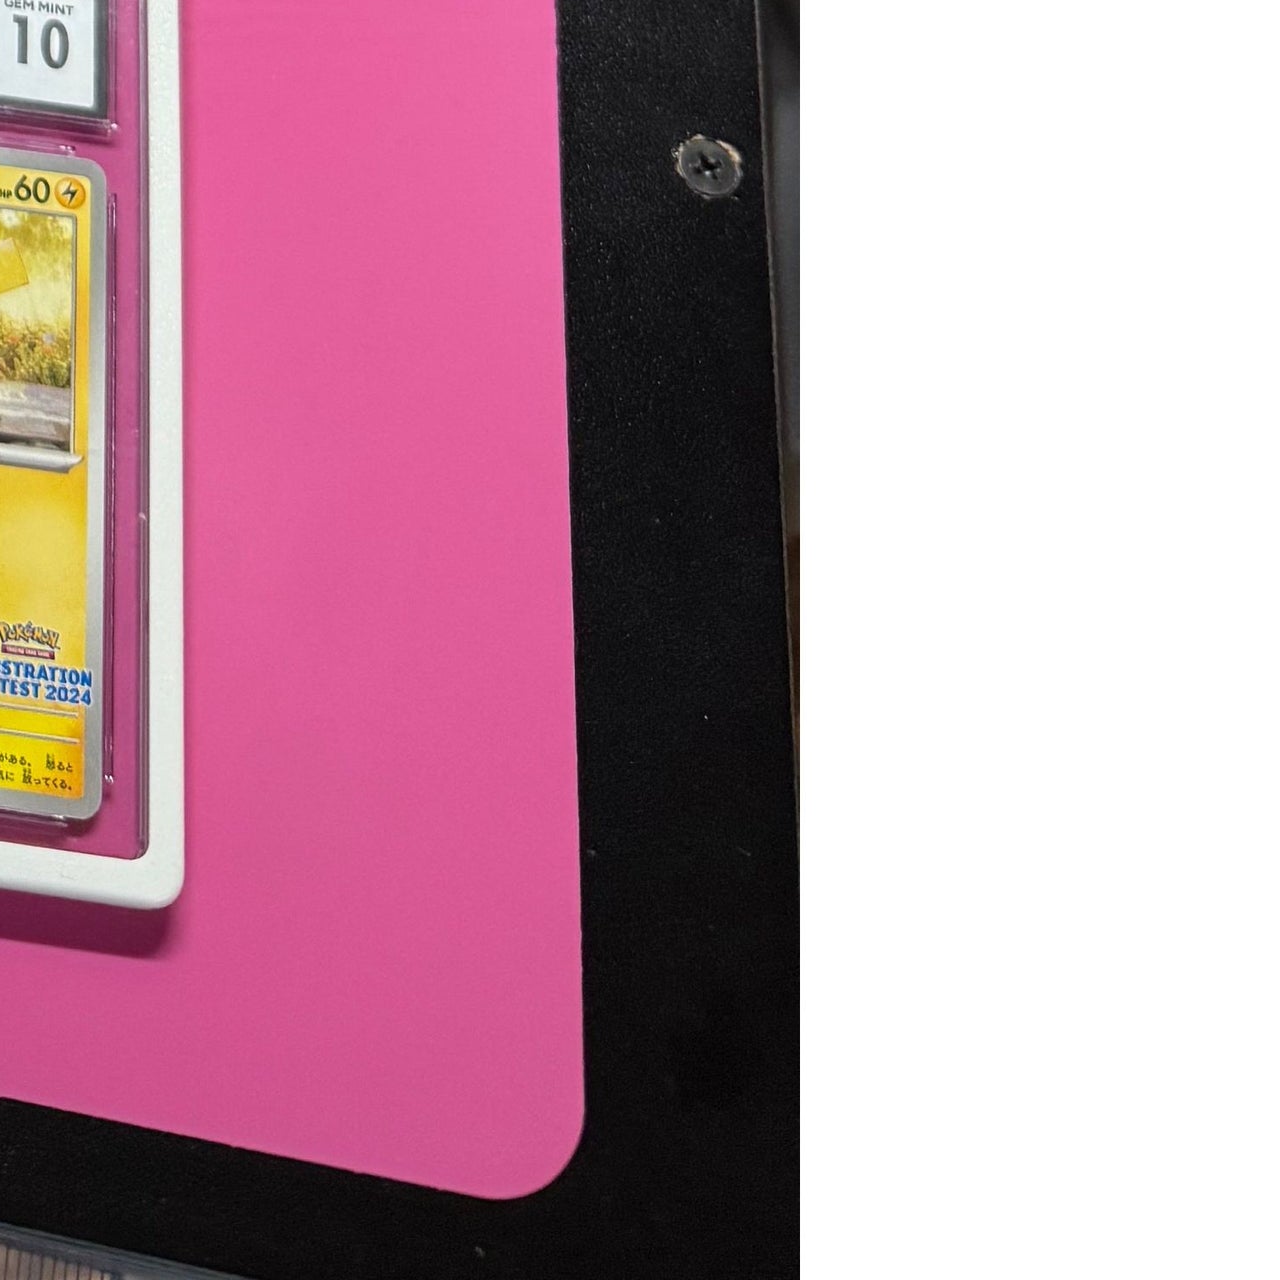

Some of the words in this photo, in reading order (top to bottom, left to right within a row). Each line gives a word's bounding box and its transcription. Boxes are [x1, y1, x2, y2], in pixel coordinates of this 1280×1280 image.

[38, 0, 75, 16] MINT
[12, 13, 70, 70] 10
[14, 174, 51, 204] 60
[44, 684, 92, 706] 2024
